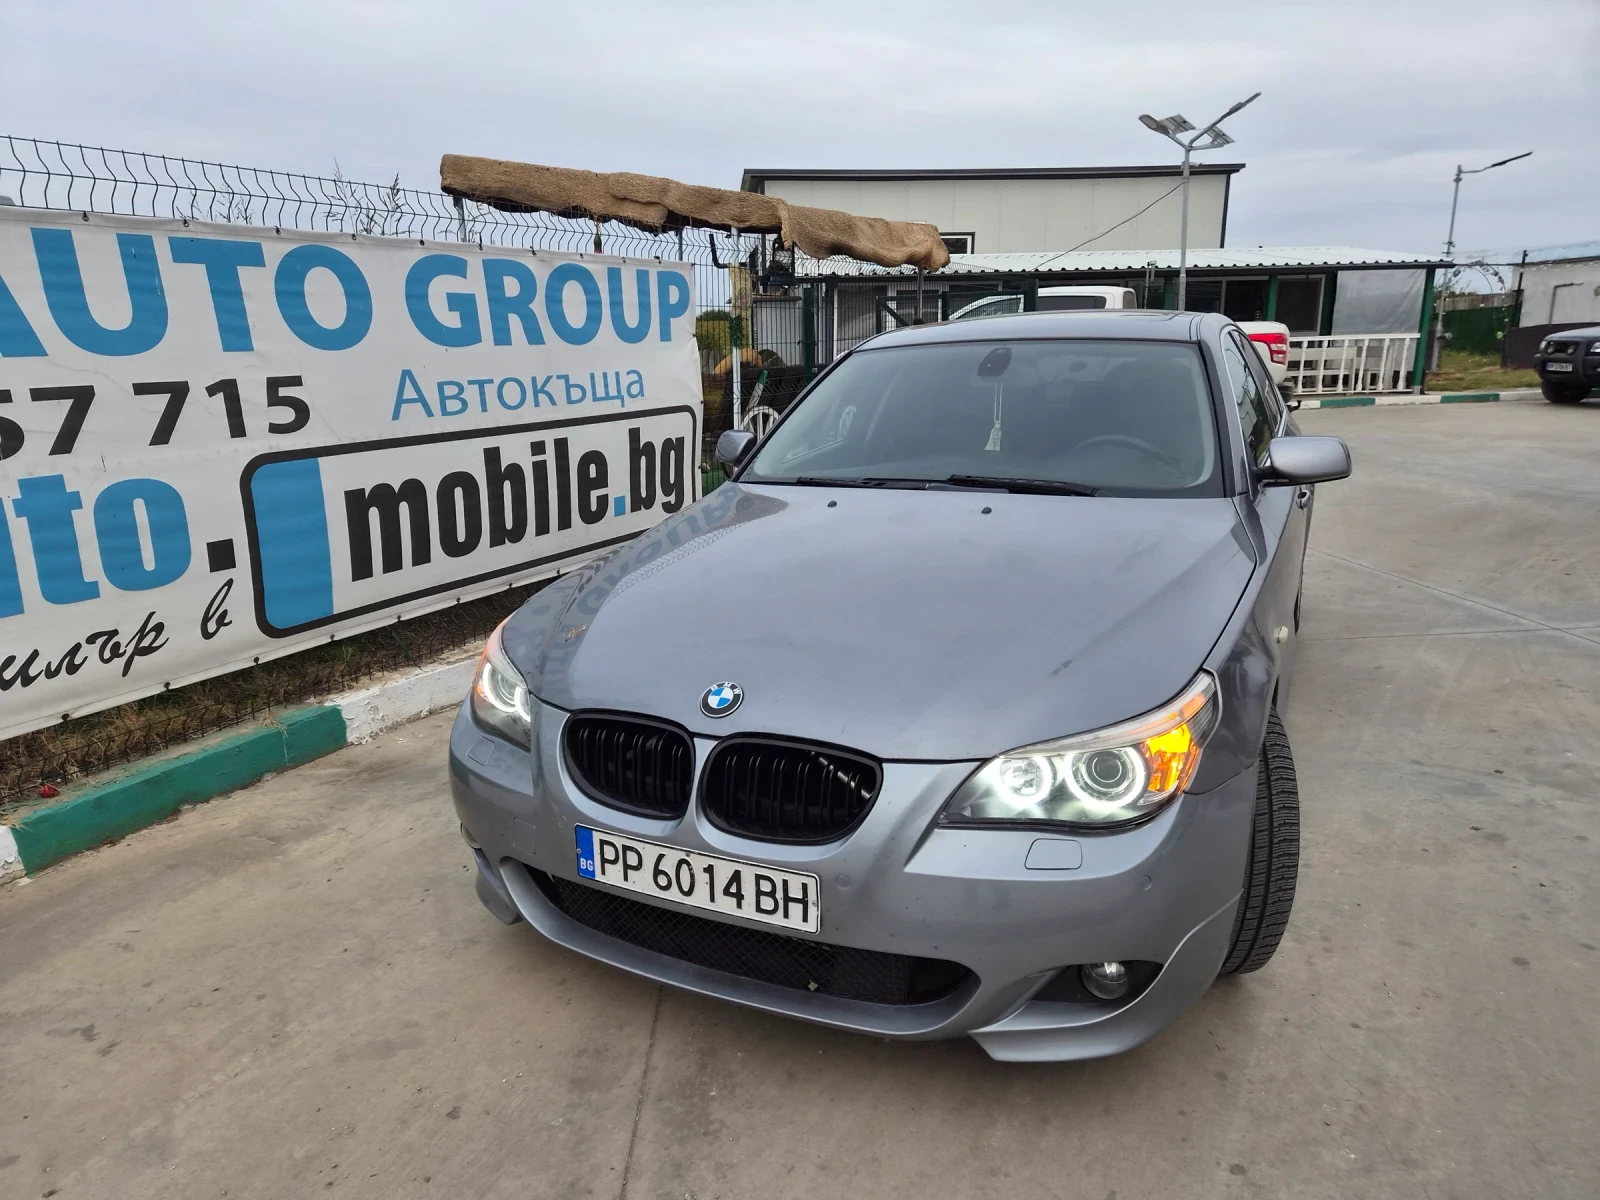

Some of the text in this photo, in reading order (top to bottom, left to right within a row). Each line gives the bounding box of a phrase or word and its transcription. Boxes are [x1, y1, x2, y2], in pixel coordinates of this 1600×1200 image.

[405, 254, 690, 348] GROUP
[132, 375, 311, 447] 715
[391, 369, 645, 421] Автокъща
[344, 427, 685, 582] mobile.bg
[710, 681, 741, 695] BMW
[580, 857, 594, 871] BG
[599, 838, 809, 923] PP 6014 BH
